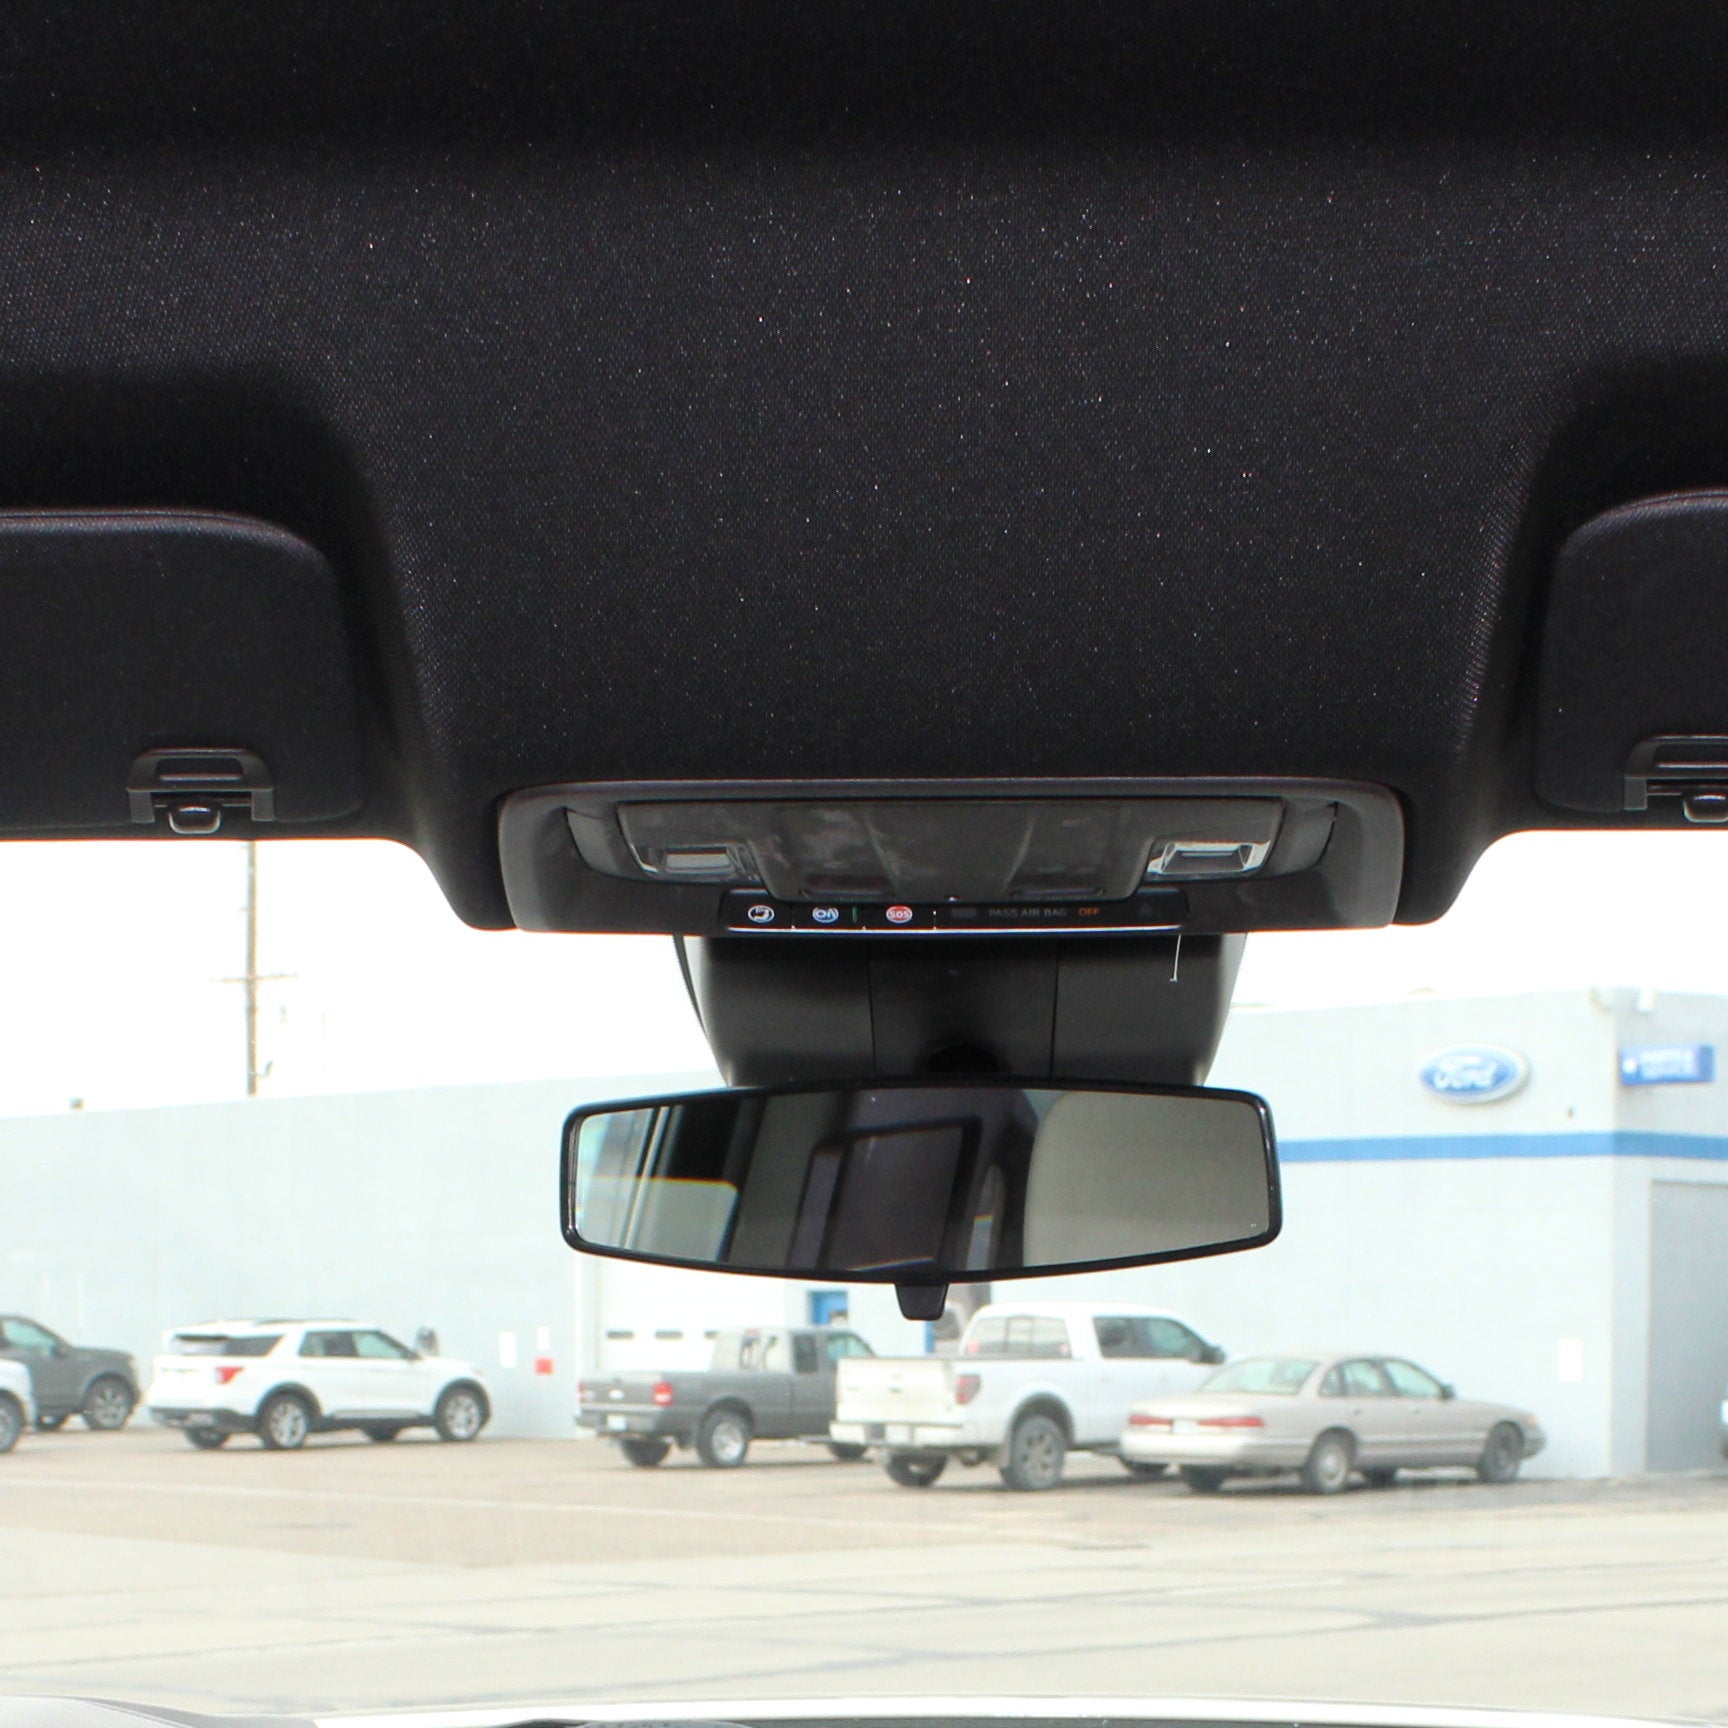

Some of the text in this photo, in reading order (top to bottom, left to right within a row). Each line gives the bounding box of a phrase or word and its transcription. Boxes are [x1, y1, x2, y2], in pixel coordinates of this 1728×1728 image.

[888, 910, 912, 918] SOS
[988, 908, 1100, 918] PASS AIR BAG OFF
[1433, 1053, 1498, 1089] Ford
